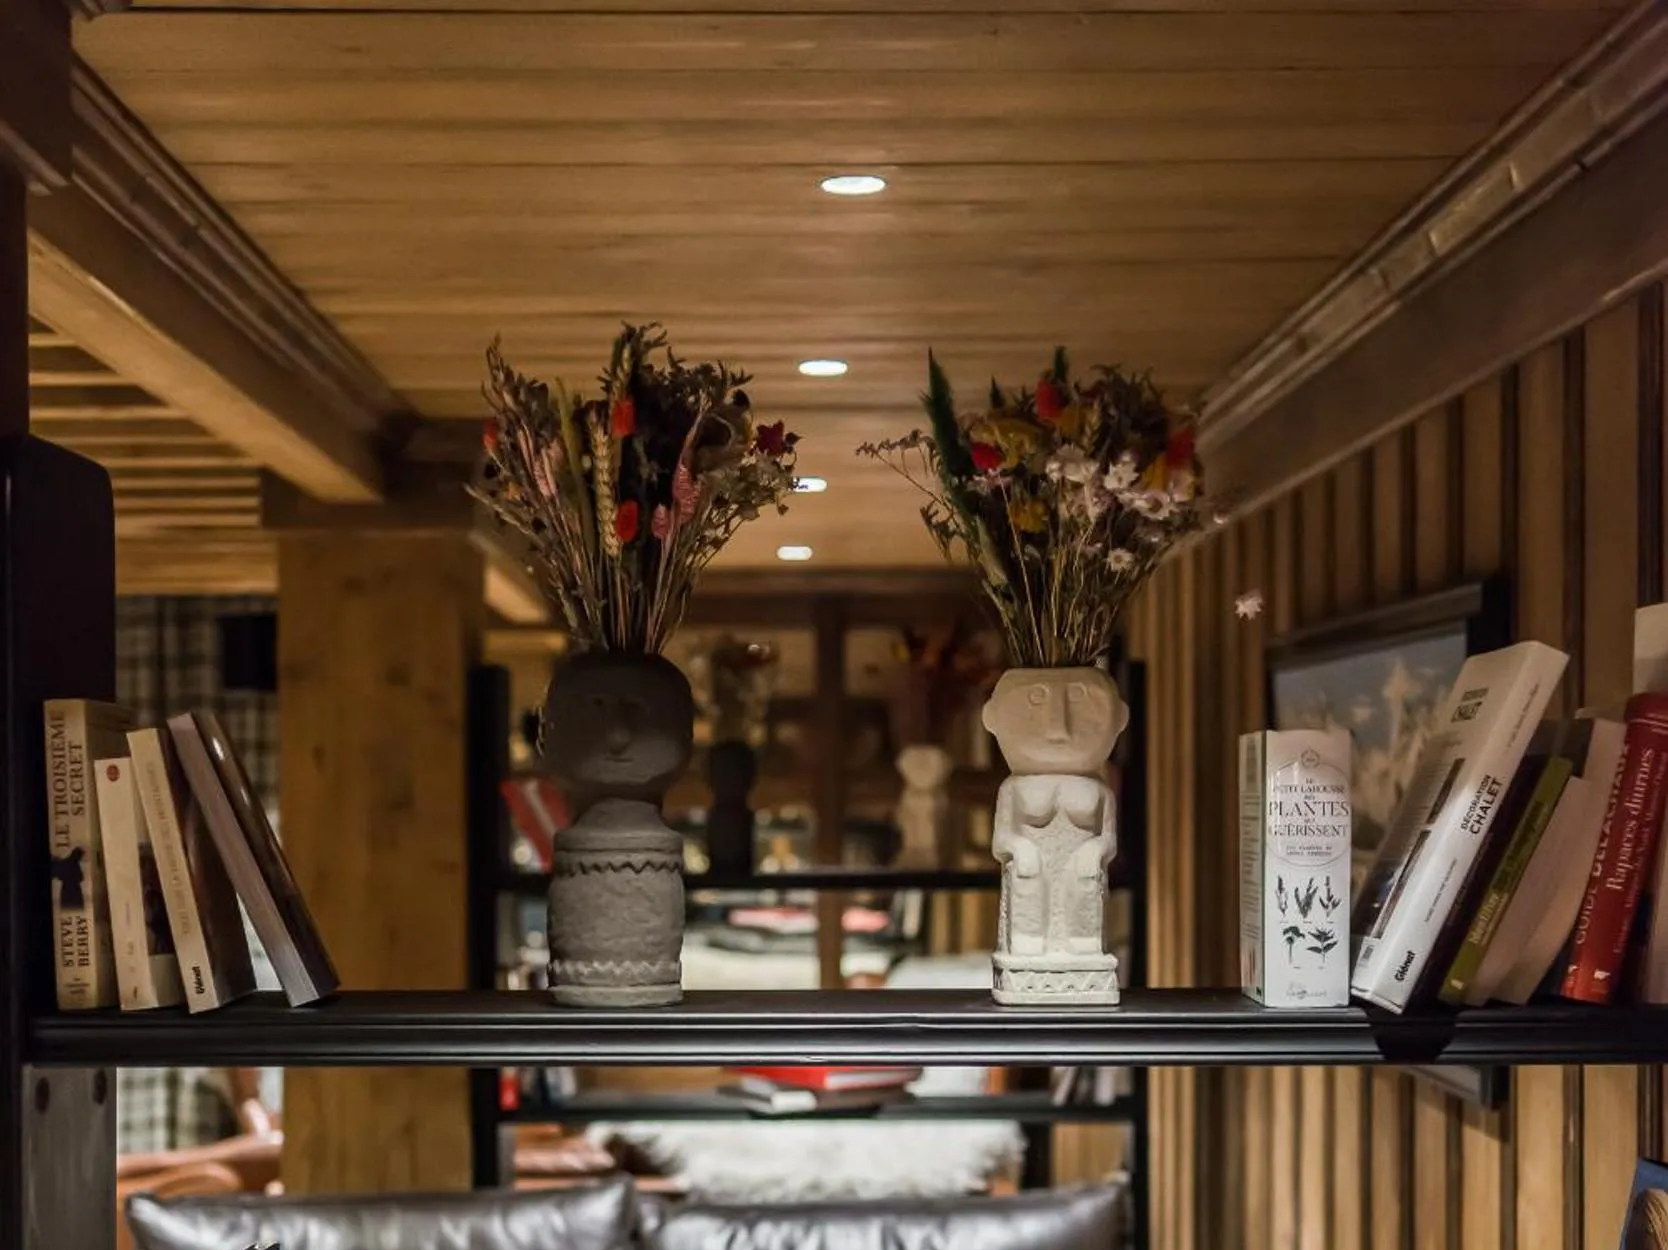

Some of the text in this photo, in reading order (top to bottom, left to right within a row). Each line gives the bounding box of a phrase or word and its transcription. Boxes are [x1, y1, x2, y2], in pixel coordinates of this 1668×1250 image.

[69, 741, 85, 816] SECRET
[1269, 800, 1350, 816] PLANTES
[1470, 778, 1503, 834] CHALET
[1606, 747, 1653, 891] Rapaces diurnes
[55, 824, 70, 848] LE
[61, 916, 74, 967] STEVE
[77, 916, 91, 967] BERRY
